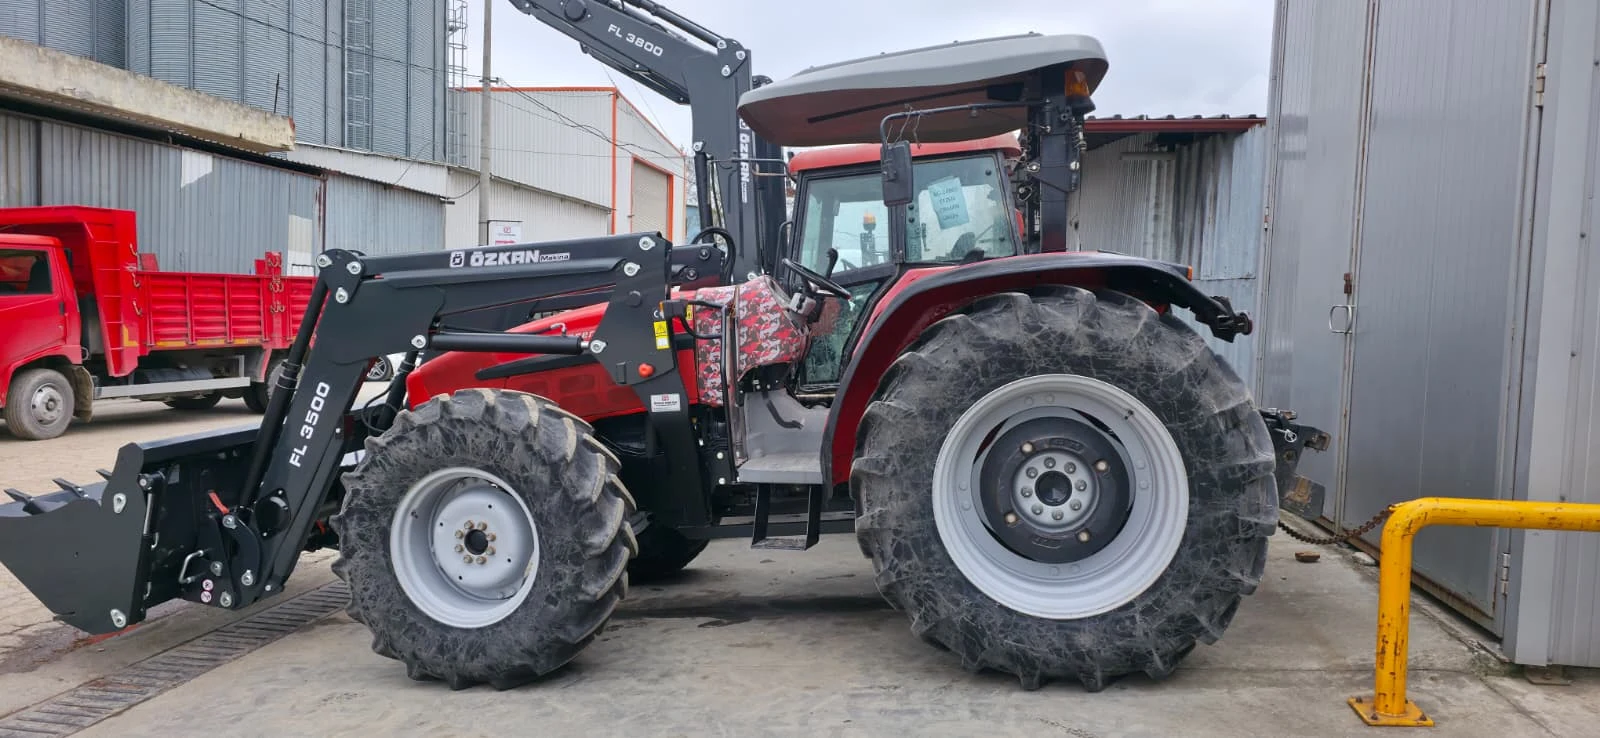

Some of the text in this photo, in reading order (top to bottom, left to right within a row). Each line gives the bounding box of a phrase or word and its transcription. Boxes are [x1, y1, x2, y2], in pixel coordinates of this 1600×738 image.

[608, 24, 664, 57] FL 3800
[470, 250, 540, 267] ÖZKAN
[541, 253, 569, 262] Makina
[289, 381, 330, 468] FL 3500
